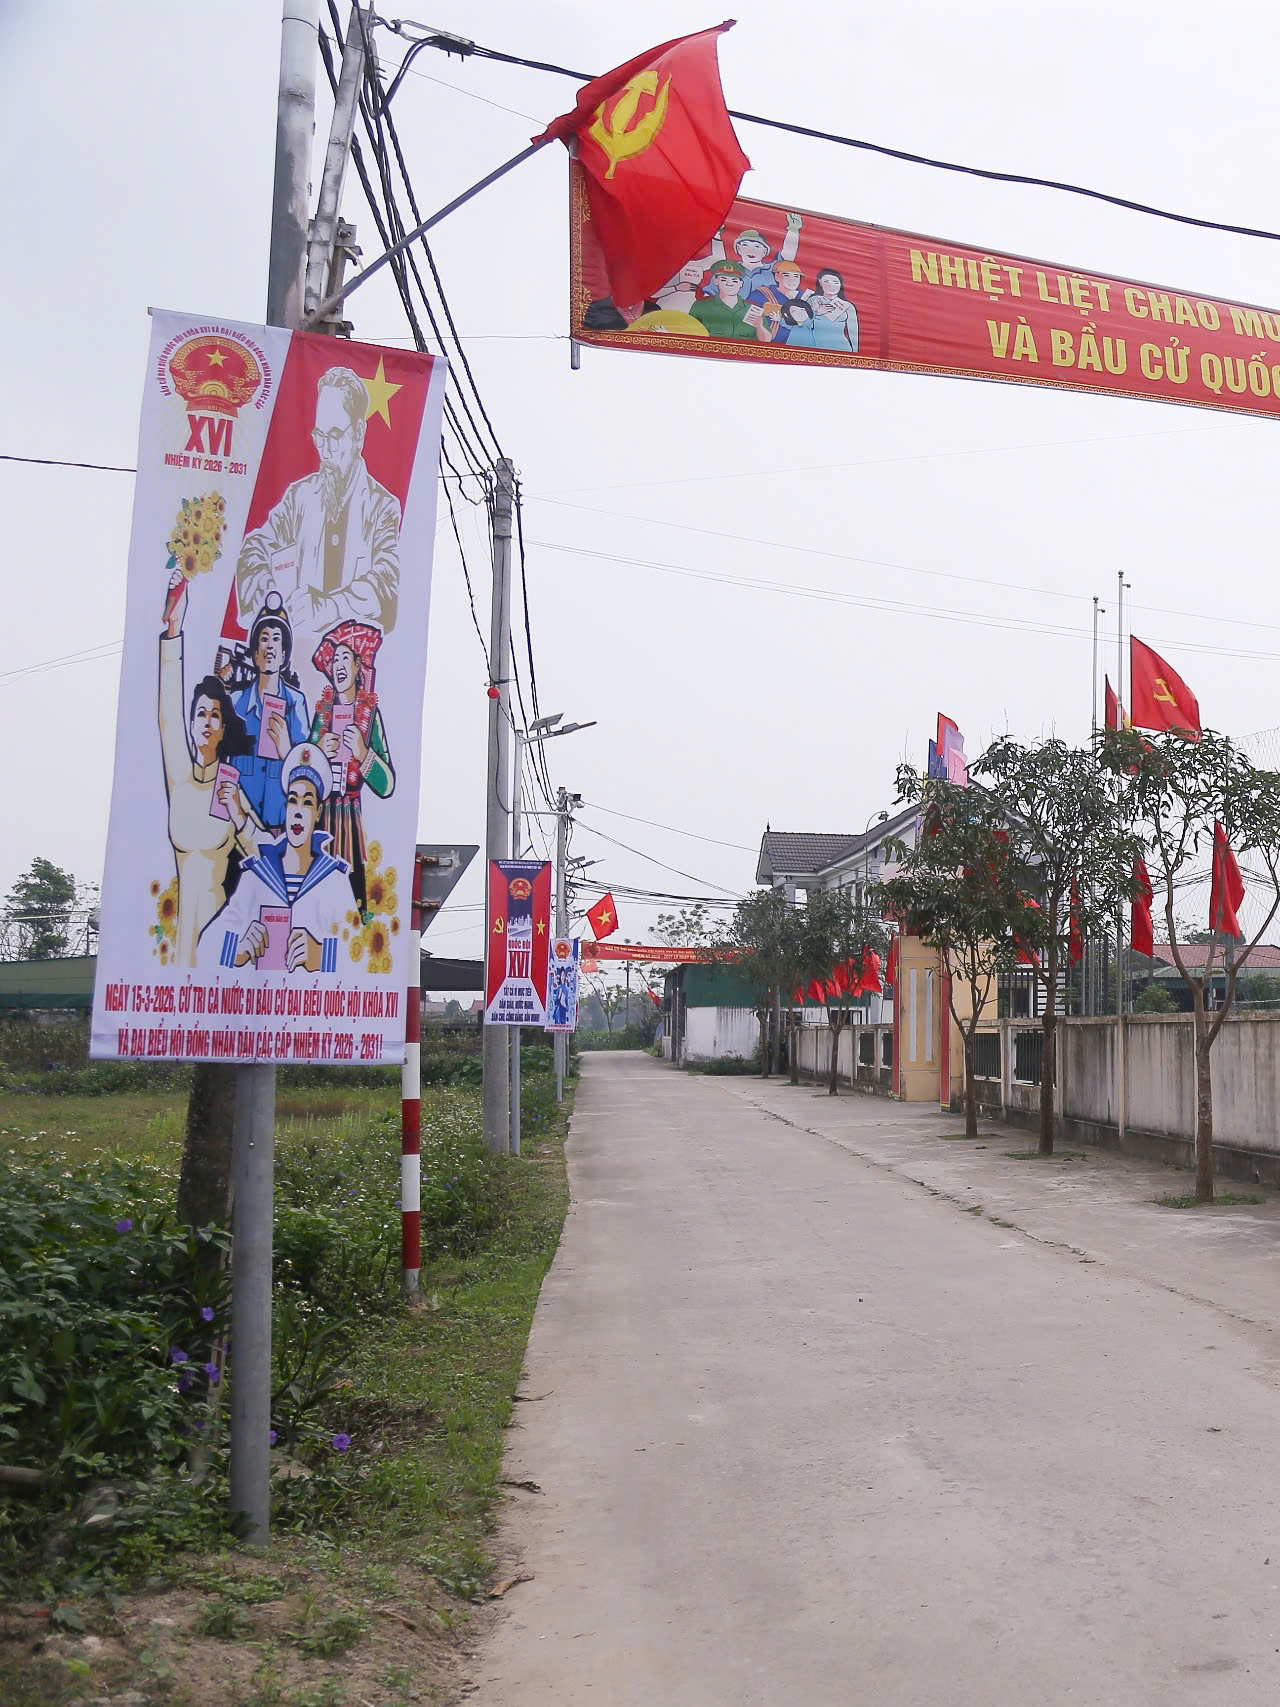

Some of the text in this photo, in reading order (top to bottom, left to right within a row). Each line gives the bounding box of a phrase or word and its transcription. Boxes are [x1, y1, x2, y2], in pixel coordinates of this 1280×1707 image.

[909, 248, 1024, 301] NHIỆT
[1035, 271, 1110, 316] LIỆT
[986, 315, 1039, 363] VÀ
[1050, 322, 1127, 376] BẦU
[1139, 336, 1191, 384] CỬ
[184, 414, 233, 457] XVI
[164, 453, 190, 469] NHIỆM
[192, 455, 202, 469] KỲ
[204, 459, 222, 472] 2026
[229, 462, 247, 475] 2031
[507, 950, 530, 978] XVI
[105, 974, 399, 1023] NGÀY 15-3-2026, CỬ TRI CẢ NƯỚC ĐI BẦU CỬ ĐẠI BIỂU QUỐC HỘI KHÓA XVI
[118, 1022, 129, 1056] VÀ
[130, 1029, 147, 1062] ĐẠI
[147, 1018, 168, 1056] BIỂU
[169, 1023, 185, 1062] HỘI
[186, 1020, 210, 1057] ĐỒNG
[211, 1025, 236, 1058] NHÂN
[237, 1025, 255, 1058] DÂN
[256, 1026, 273, 1058] CÁC
[274, 1022, 291, 1059] CẤP
[293, 1027, 320, 1064] NHIỆM
[321, 1027, 333, 1059] KỲ
[334, 1033, 353, 1059] 2026
[360, 1033, 383, 1060] 2031!
